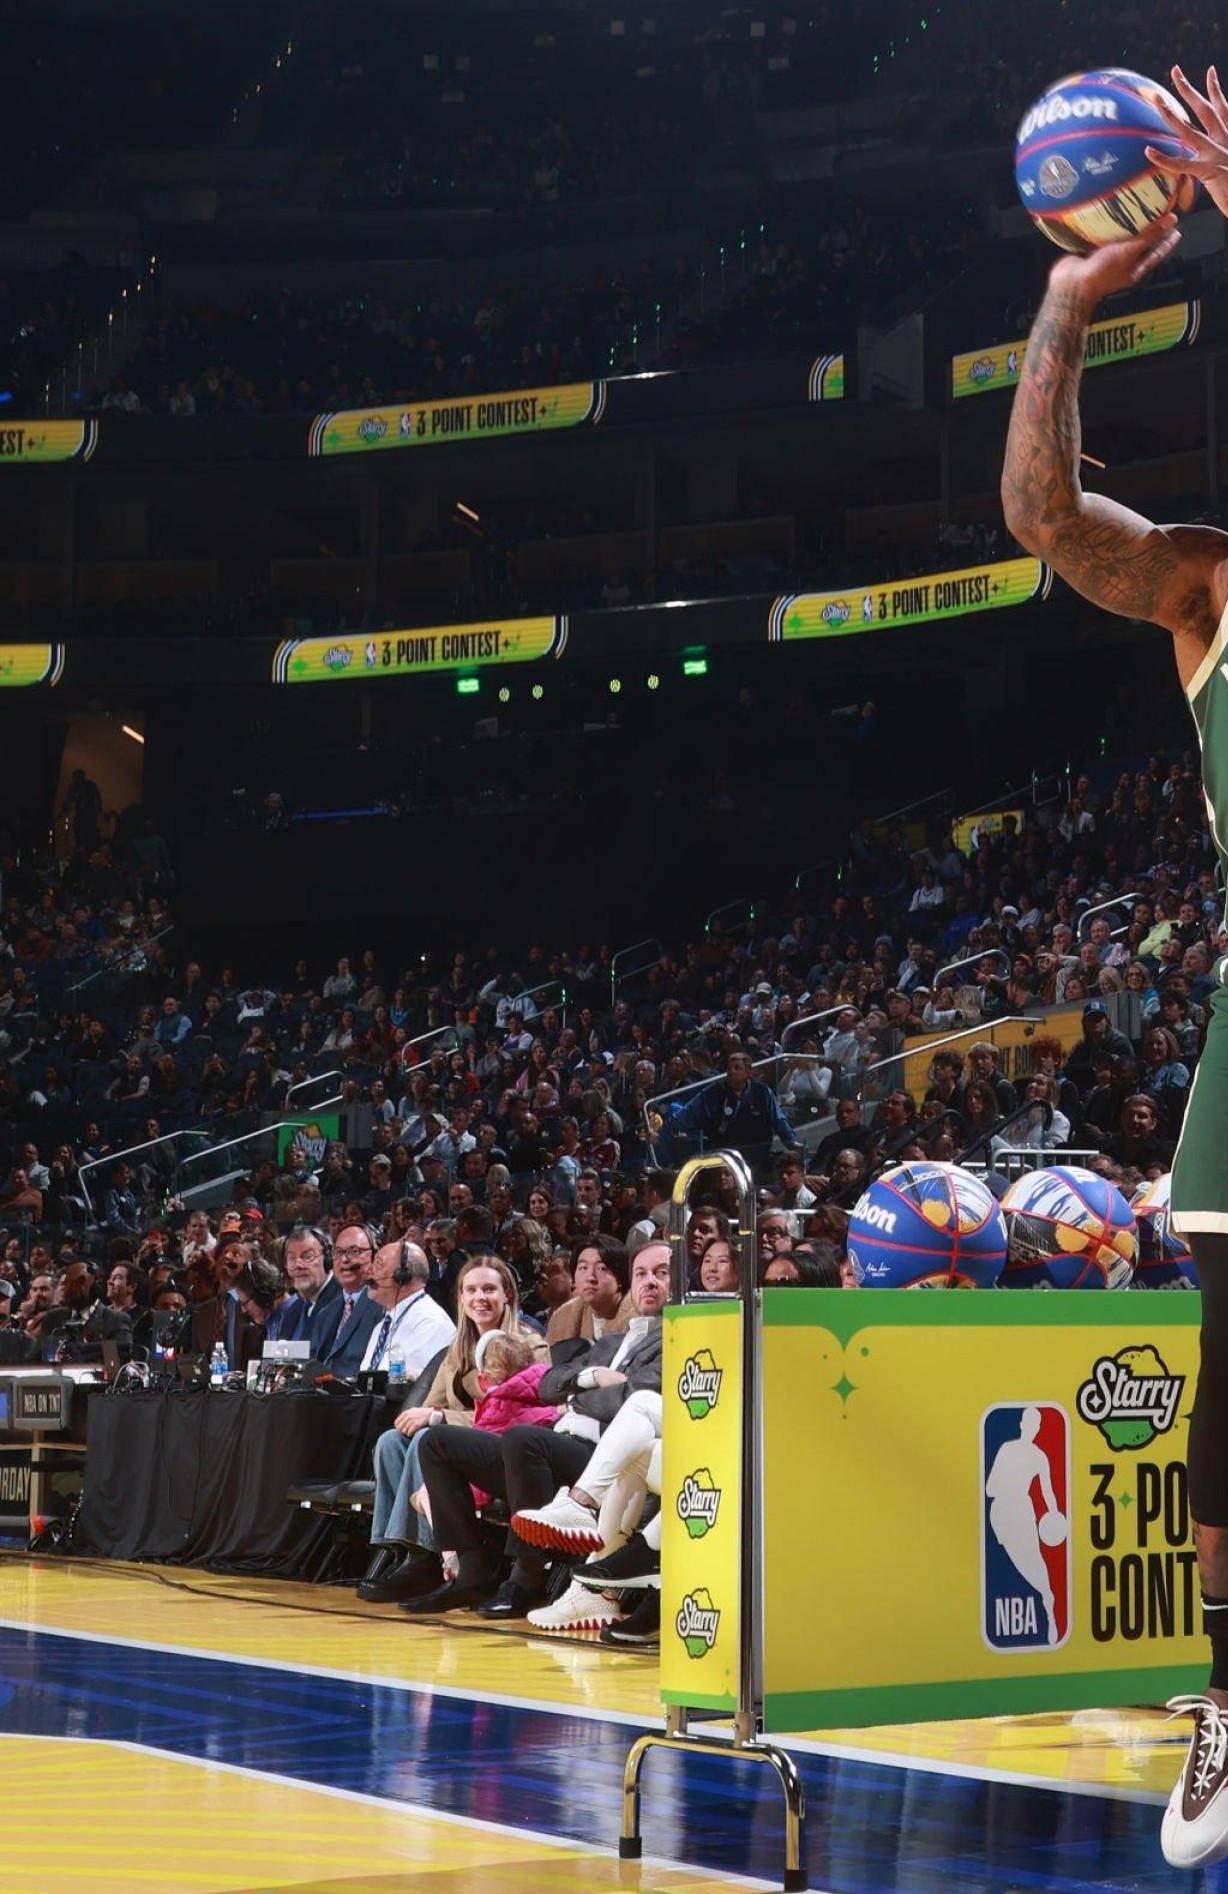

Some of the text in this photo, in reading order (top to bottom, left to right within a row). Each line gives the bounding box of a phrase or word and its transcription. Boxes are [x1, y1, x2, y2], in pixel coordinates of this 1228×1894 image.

[1084, 322, 1136, 360] ONTEST
[417, 397, 538, 436] 3 POINT CONTEST
[878, 575, 990, 619] 3 POINT CONTEST
[382, 631, 501, 666] 3 POINT CONTEST
[24, 1393, 36, 1413] NBA
[38, 1393, 48, 1413] ON
[679, 1359, 722, 1405] Starry
[1080, 1360, 1181, 1430] Starry
[0, 1467, 30, 1501] RDAY
[678, 1478, 721, 1526] Starry
[1089, 1461, 1196, 1550] 3 PO
[995, 1596, 1038, 1637] NBA
[1091, 1552, 1208, 1642] CONT
[677, 1597, 720, 1645] Starry
